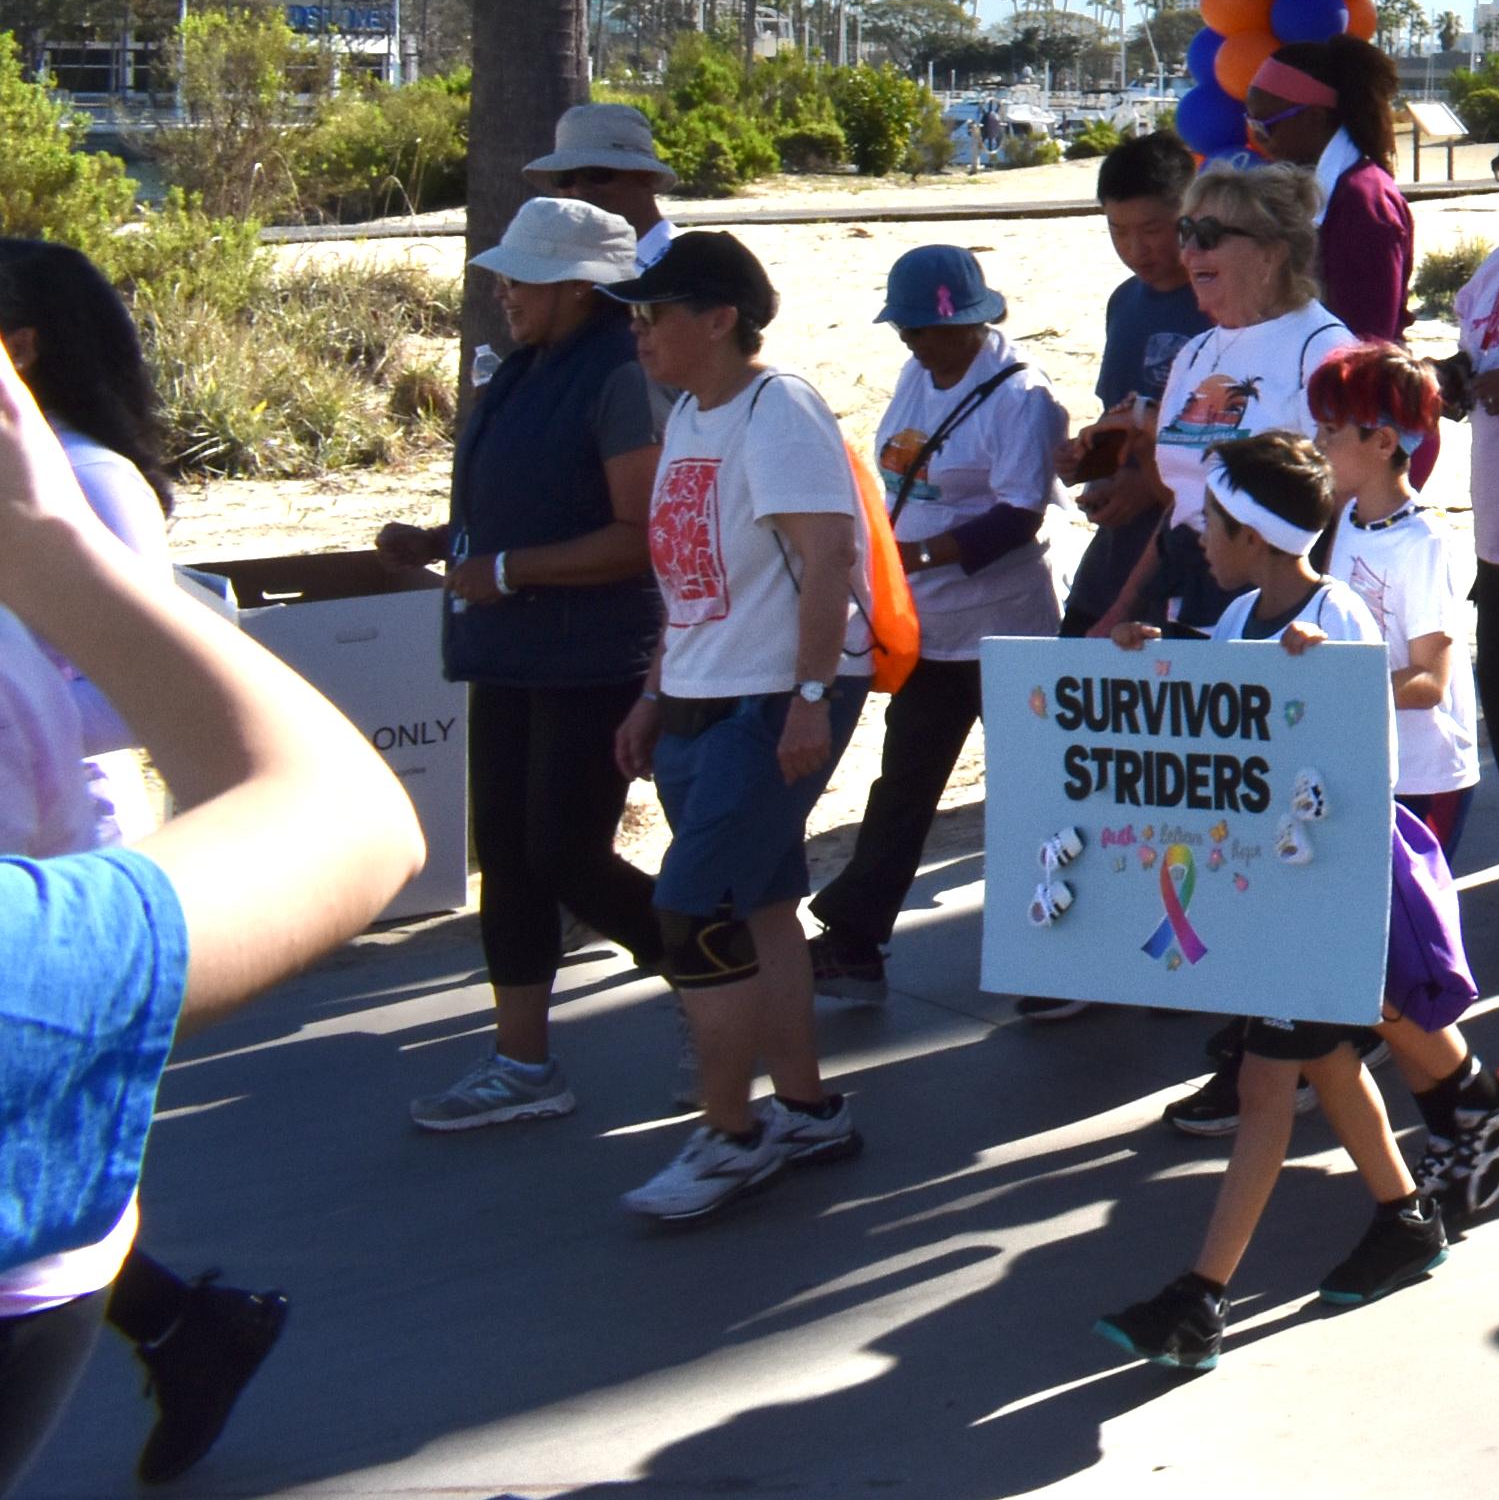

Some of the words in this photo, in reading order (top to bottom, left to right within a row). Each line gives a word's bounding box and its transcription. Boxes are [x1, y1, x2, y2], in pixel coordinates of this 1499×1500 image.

[373, 717, 456, 751] ONLY
[1055, 676, 1271, 741] SURVIVOR
[1064, 744, 1271, 814] STRIDERS
